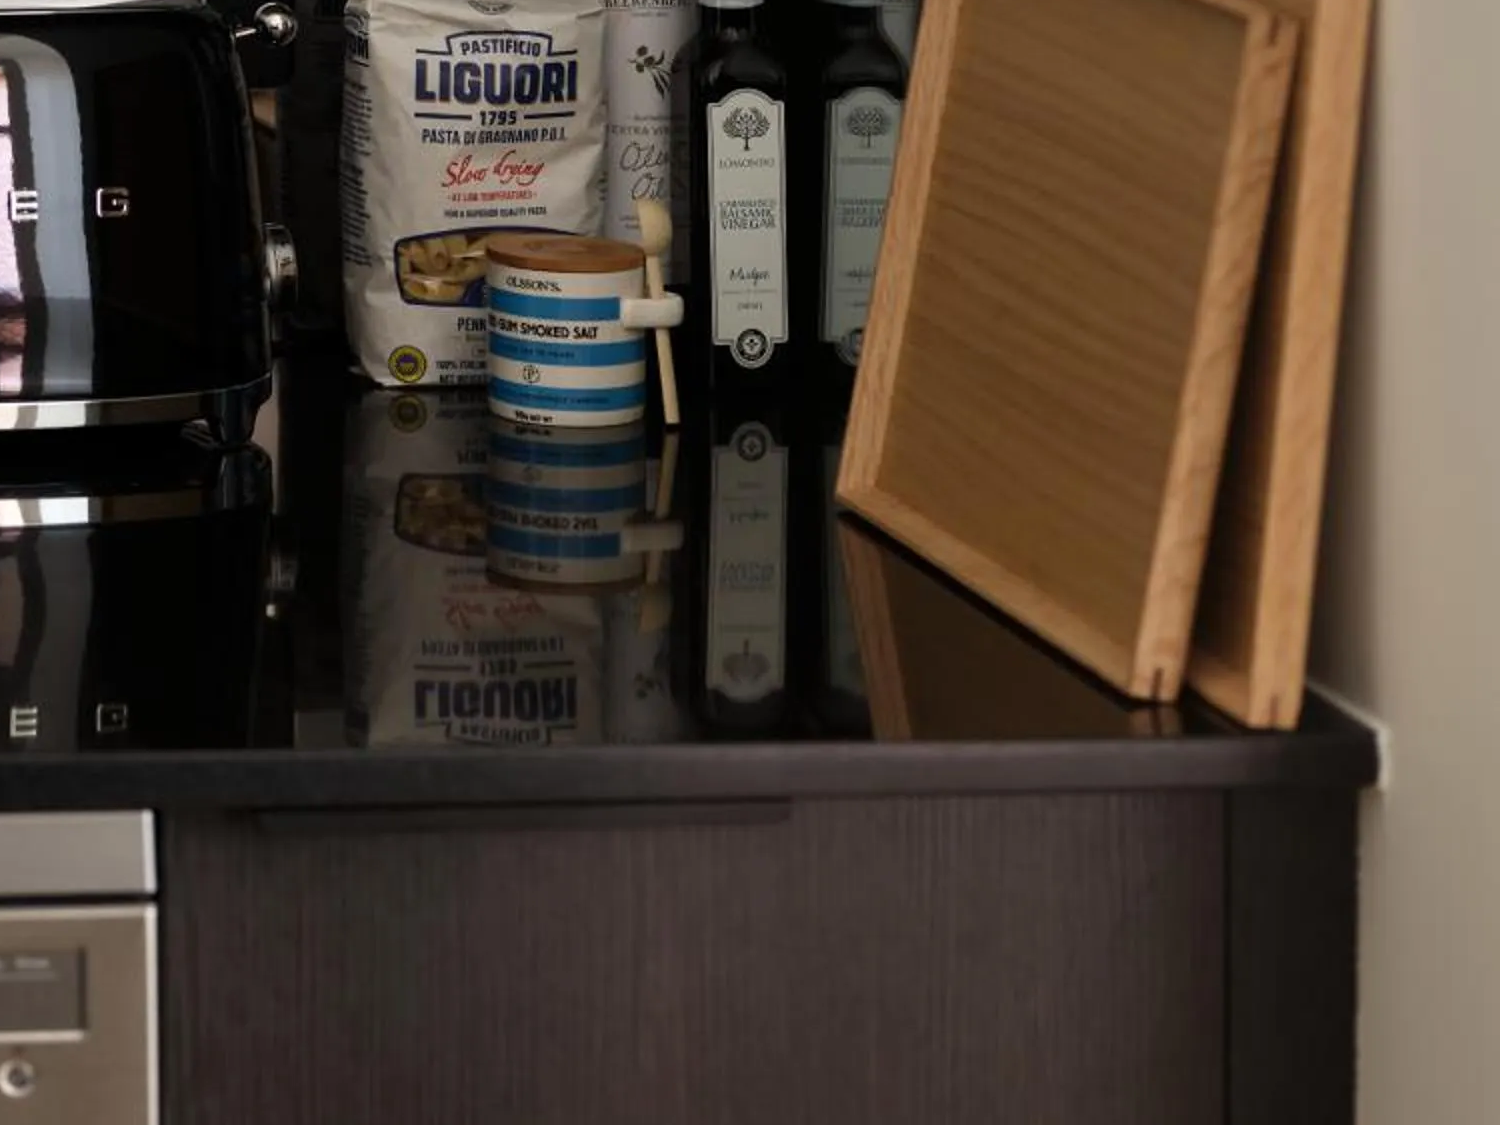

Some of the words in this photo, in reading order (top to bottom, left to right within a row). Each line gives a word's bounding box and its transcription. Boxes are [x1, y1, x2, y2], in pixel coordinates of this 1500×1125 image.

[460, 38, 541, 57] PASTIFICIO
[415, 59, 577, 105] LIGUORI
[479, 111, 517, 125] 1795
[422, 128, 460, 145] PASTA
[464, 130, 476, 146] DI
[441, 154, 486, 188] Slow
[721, 218, 776, 230] VINEGAR
[457, 317, 487, 332] PENN
[520, 321, 570, 339] SMOKED
[573, 326, 599, 339] SALT
